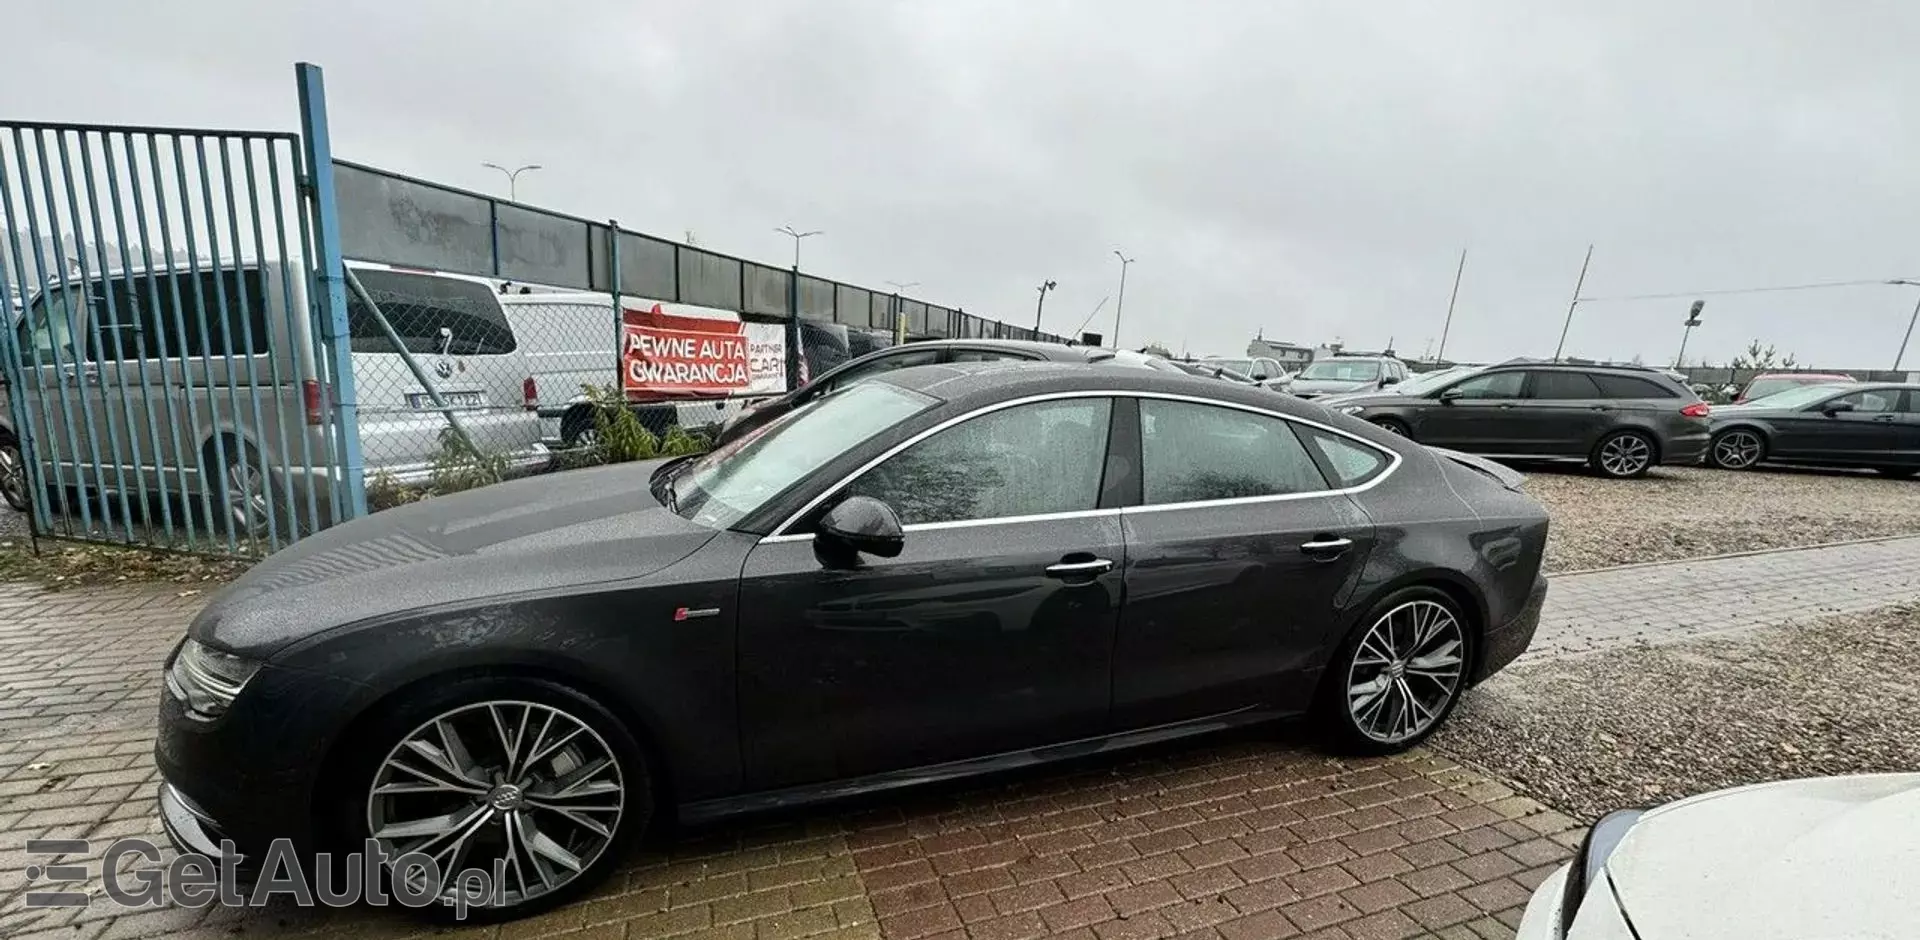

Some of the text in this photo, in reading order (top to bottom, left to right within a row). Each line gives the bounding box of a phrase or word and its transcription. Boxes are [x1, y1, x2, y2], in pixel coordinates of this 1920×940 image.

[628, 333, 746, 360] PEWNE AUTA
[629, 358, 748, 384] GWARANCJA
